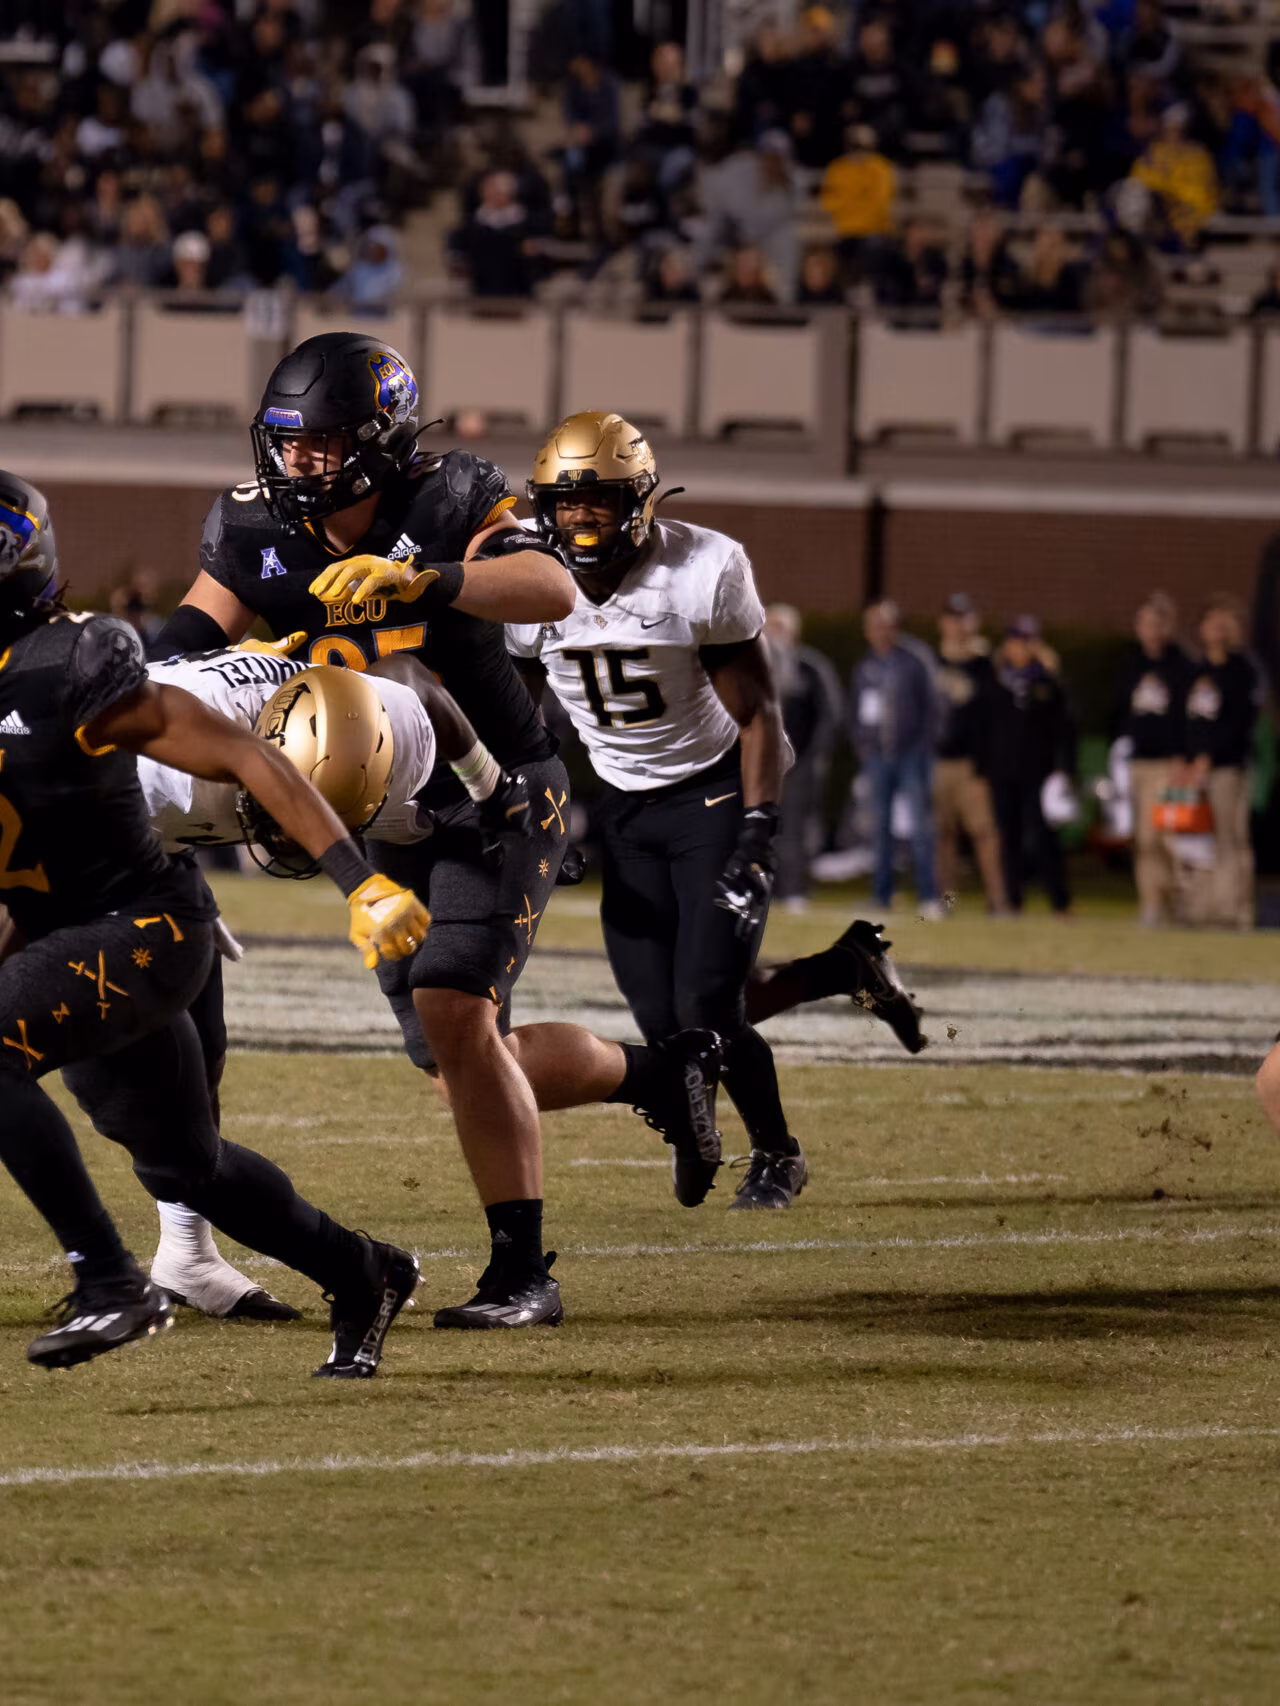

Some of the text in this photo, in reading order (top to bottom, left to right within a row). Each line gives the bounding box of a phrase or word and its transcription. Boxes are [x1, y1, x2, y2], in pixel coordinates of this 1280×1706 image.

[378, 362, 396, 380] ECU
[567, 470, 582, 481] 407
[387, 544, 422, 561] adidas
[323, 597, 387, 628] ECU
[560, 647, 667, 729] 15
